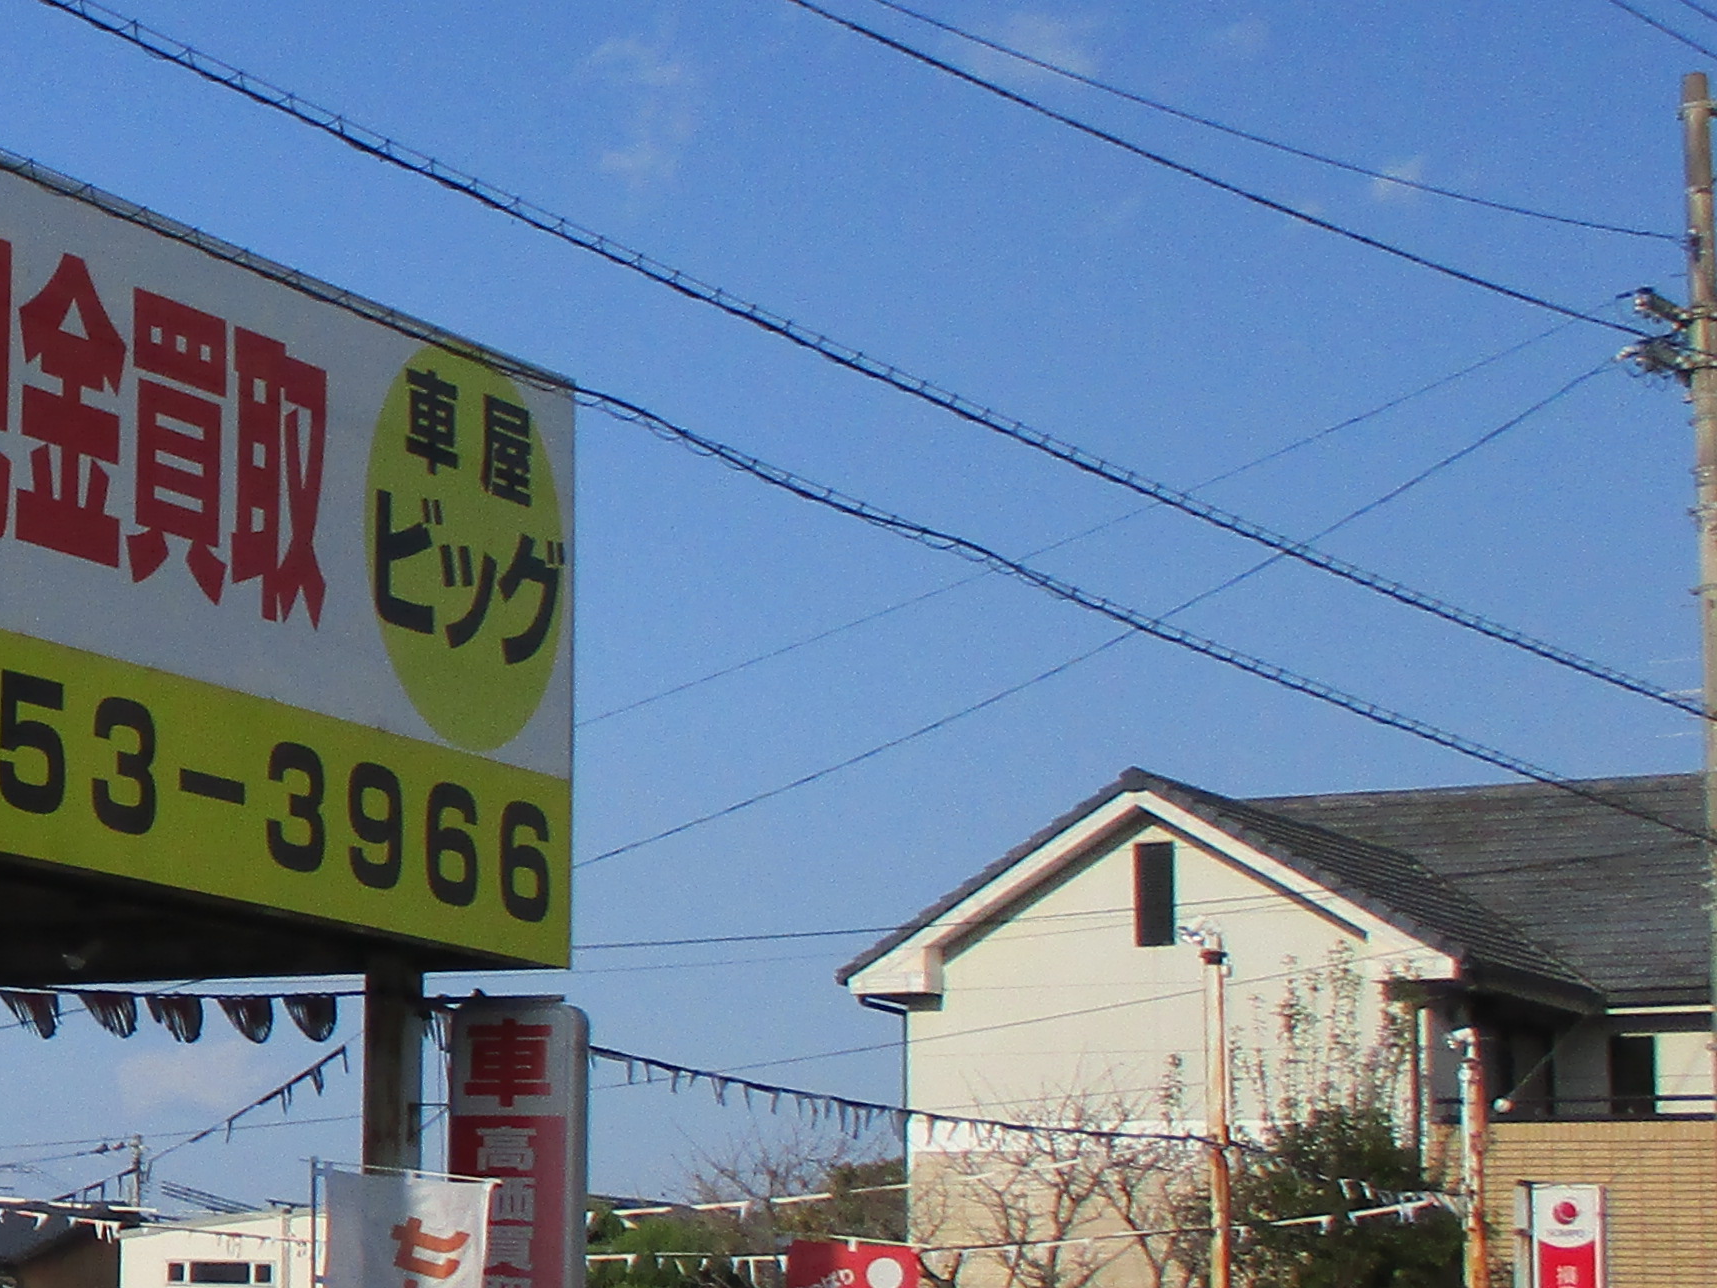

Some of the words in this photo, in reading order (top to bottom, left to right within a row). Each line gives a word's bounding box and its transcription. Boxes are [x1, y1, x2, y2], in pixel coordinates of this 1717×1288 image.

[404, 368, 534, 508] 車屋
[373, 486, 565, 666] ビッグ
[464, 1018, 553, 1108] 車
